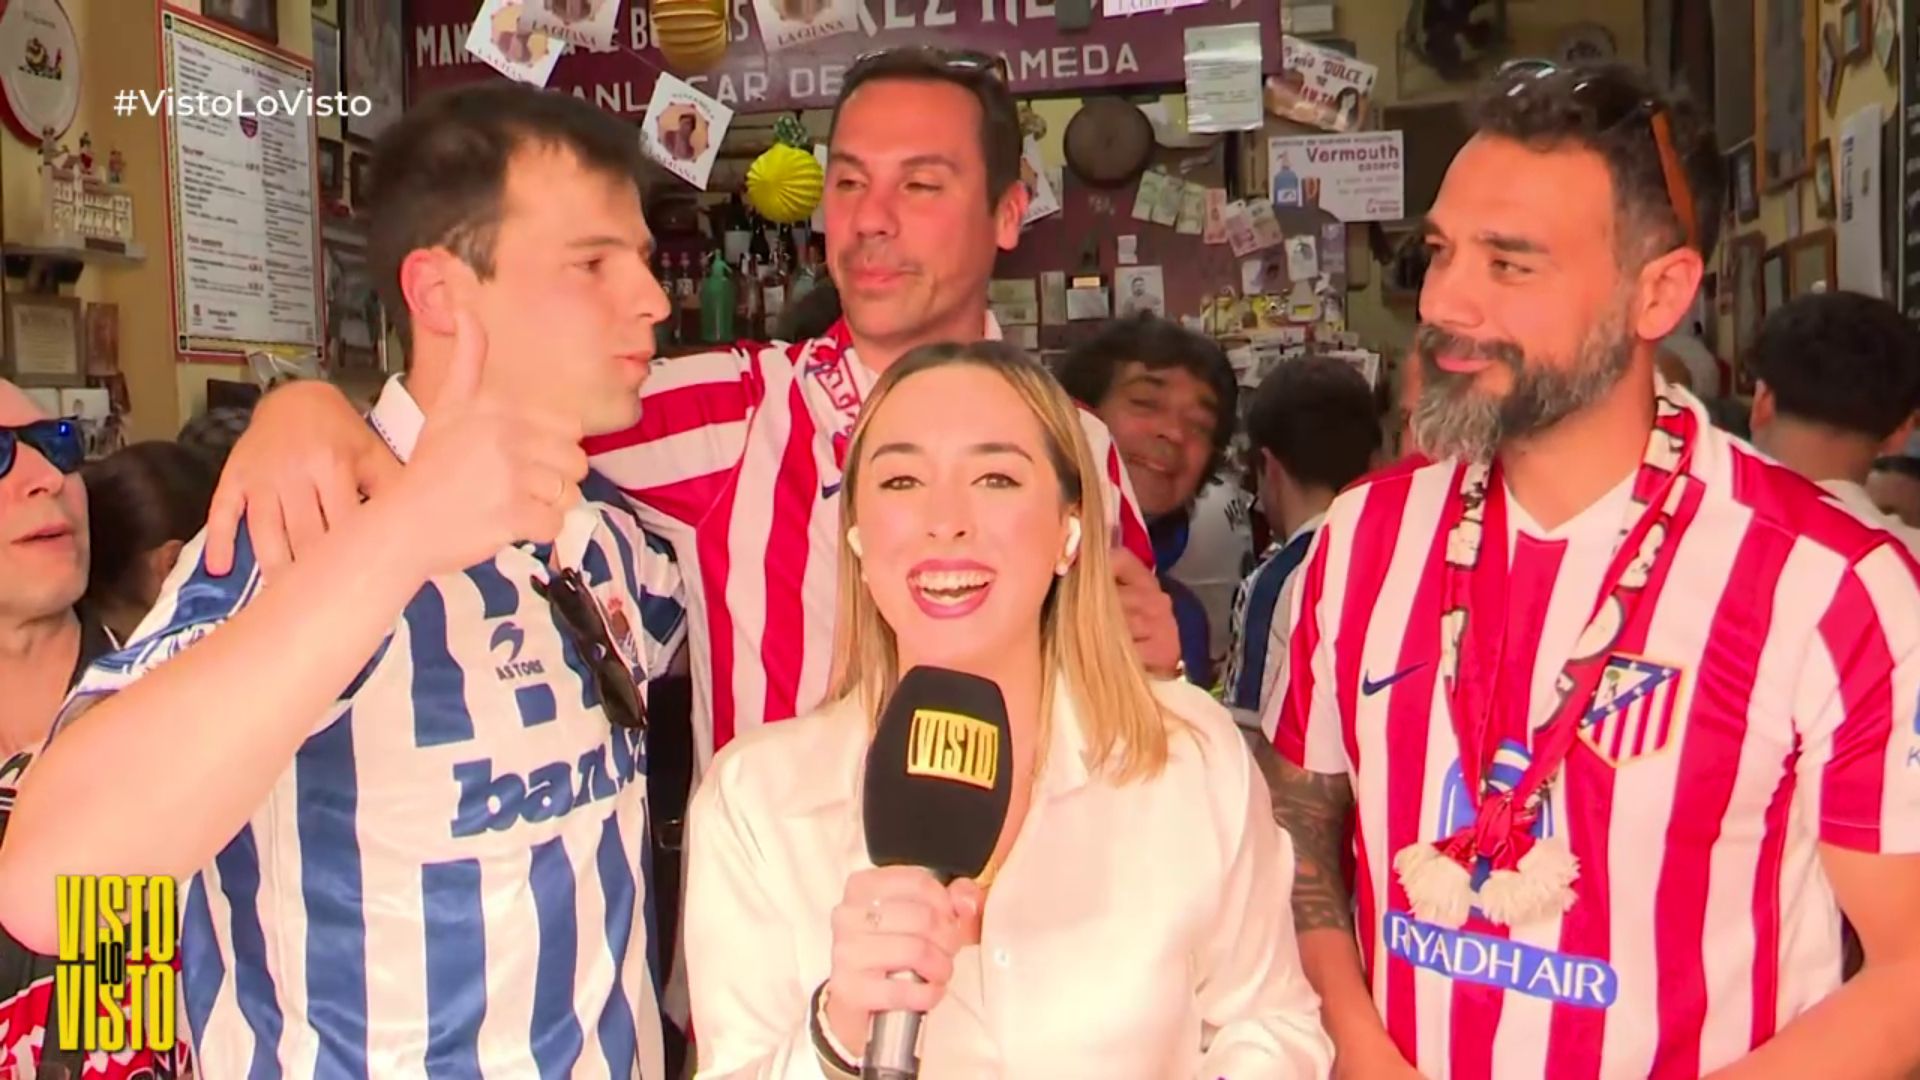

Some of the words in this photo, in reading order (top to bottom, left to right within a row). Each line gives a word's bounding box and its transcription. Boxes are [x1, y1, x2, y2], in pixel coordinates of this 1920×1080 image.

[789, 64, 847, 98] DE
[1306, 144, 1400, 163] Vermouth
[908, 709, 998, 790] VISTO
[1390, 915, 1521, 985] RYADH
[1527, 954, 1608, 1004] AIR
